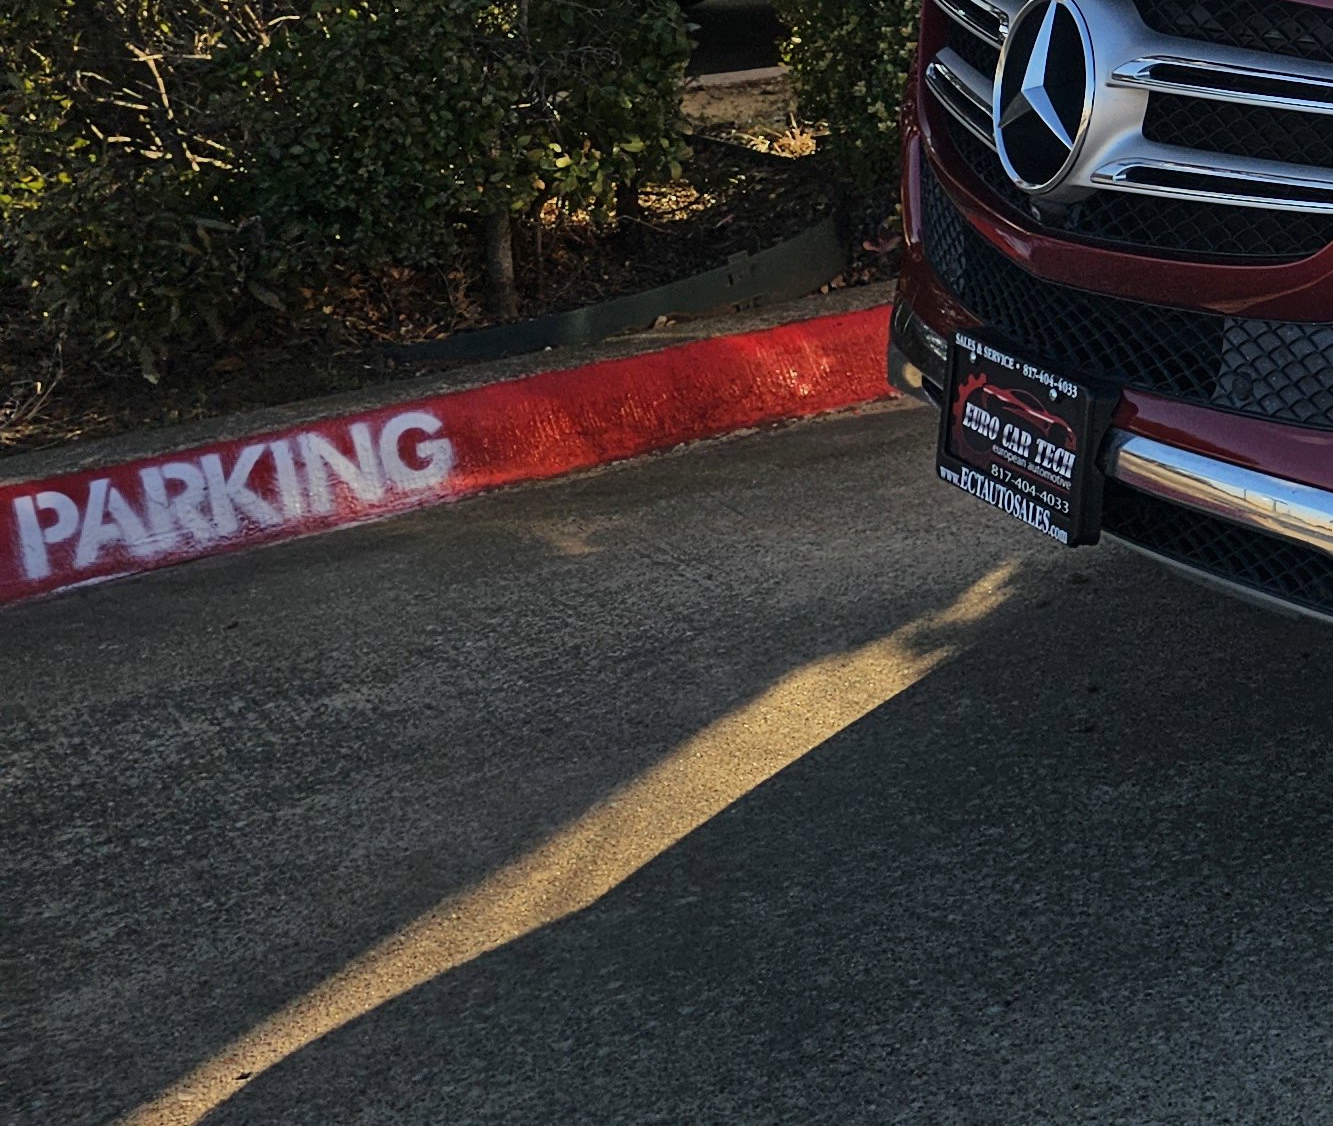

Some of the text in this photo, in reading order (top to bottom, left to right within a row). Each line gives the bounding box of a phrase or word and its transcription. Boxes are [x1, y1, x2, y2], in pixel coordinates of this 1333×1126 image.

[956, 333, 1078, 398] SALES & SERVICE 817-404-4033
[963, 401, 1076, 479] EURO CAR TECH
[992, 444, 1072, 490] european automotive
[13, 411, 456, 580] PARKING
[940, 466, 1068, 545] www.ECTAUTOSALES.com
[991, 464, 1070, 514] 817-404-4033
